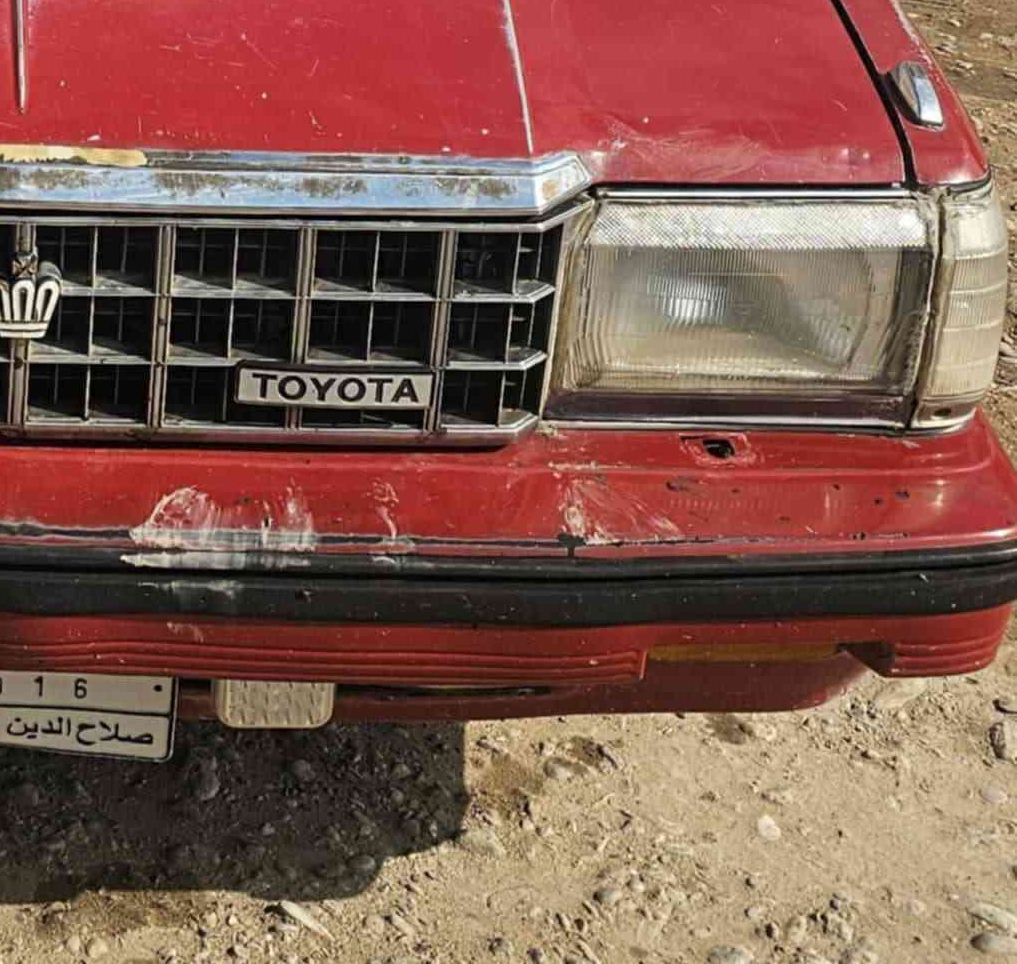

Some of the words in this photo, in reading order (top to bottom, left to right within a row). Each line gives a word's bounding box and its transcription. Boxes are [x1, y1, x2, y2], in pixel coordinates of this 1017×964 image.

[252, 372, 419, 404] TOYOTA
[6, 717, 71, 739] الدين
[76, 720, 154, 746] صلاح
